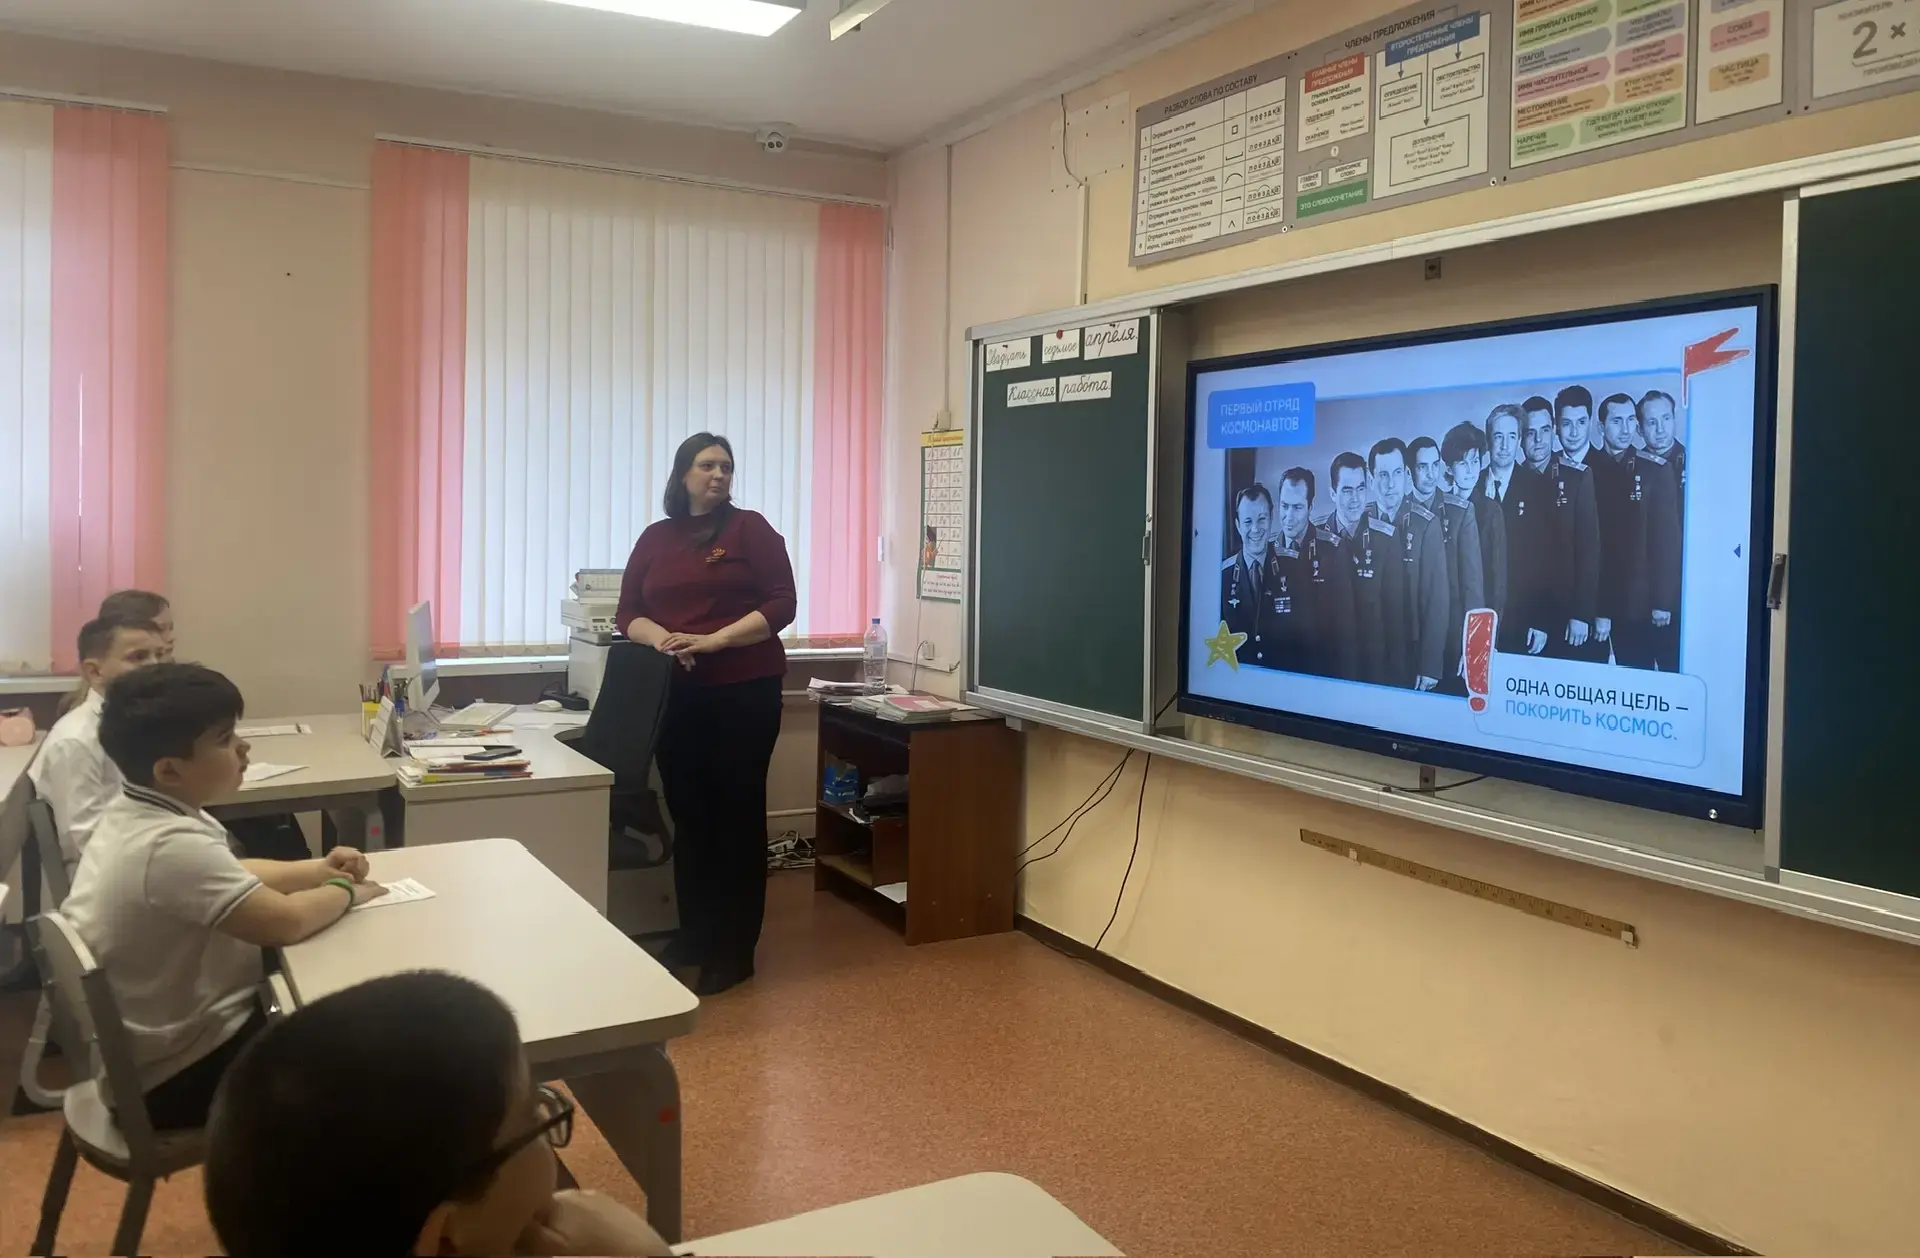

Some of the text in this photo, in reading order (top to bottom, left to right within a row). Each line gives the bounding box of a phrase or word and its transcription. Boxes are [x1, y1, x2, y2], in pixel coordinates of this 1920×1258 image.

[1344, 10, 1435, 49] ЧЛЕНЫ ПРЕДЛОЖЕНИЯ
[1519, 28, 1534, 38] ИМЯ
[1535, 6, 1598, 32] ПРИЛАГАТЕЛЬНОЕ
[1391, 24, 1449, 51] ВТОРОСТЕПЕННЫЕ
[1853, 21, 1878, 59] 2
[1518, 50, 1545, 64] ГЛАГОЛ
[1719, 57, 1760, 74] ЧАСТИЦА
[1517, 82, 1533, 91] ИМЯ
[1534, 65, 1588, 85] ЧИСЛИТЕЛЬНОЕ
[1164, 75, 1258, 115] РАЗБОР СЛОВА ПО СОСТАВУ
[1518, 96, 1568, 115] МЕСТОИМЕНИЕ
[1517, 132, 1547, 144] НАРЕЧИЕ
[1300, 188, 1364, 211] ЭТО СЛОВОСОЧЕТАНИЕ
[1008, 385, 1056, 401] Классная
[1220, 397, 1300, 416] ПЕРВЫЙ ОТРЯД
[1220, 416, 1300, 435] КОСМОНАВТОВ
[1506, 677, 1550, 696] ОДНА
[1554, 683, 1616, 705] ОБЩАЯ
[1621, 691, 1670, 712] ЦЕЛЬ
[1505, 699, 1678, 741] ПОКОРИТЬ КОСМОС.
